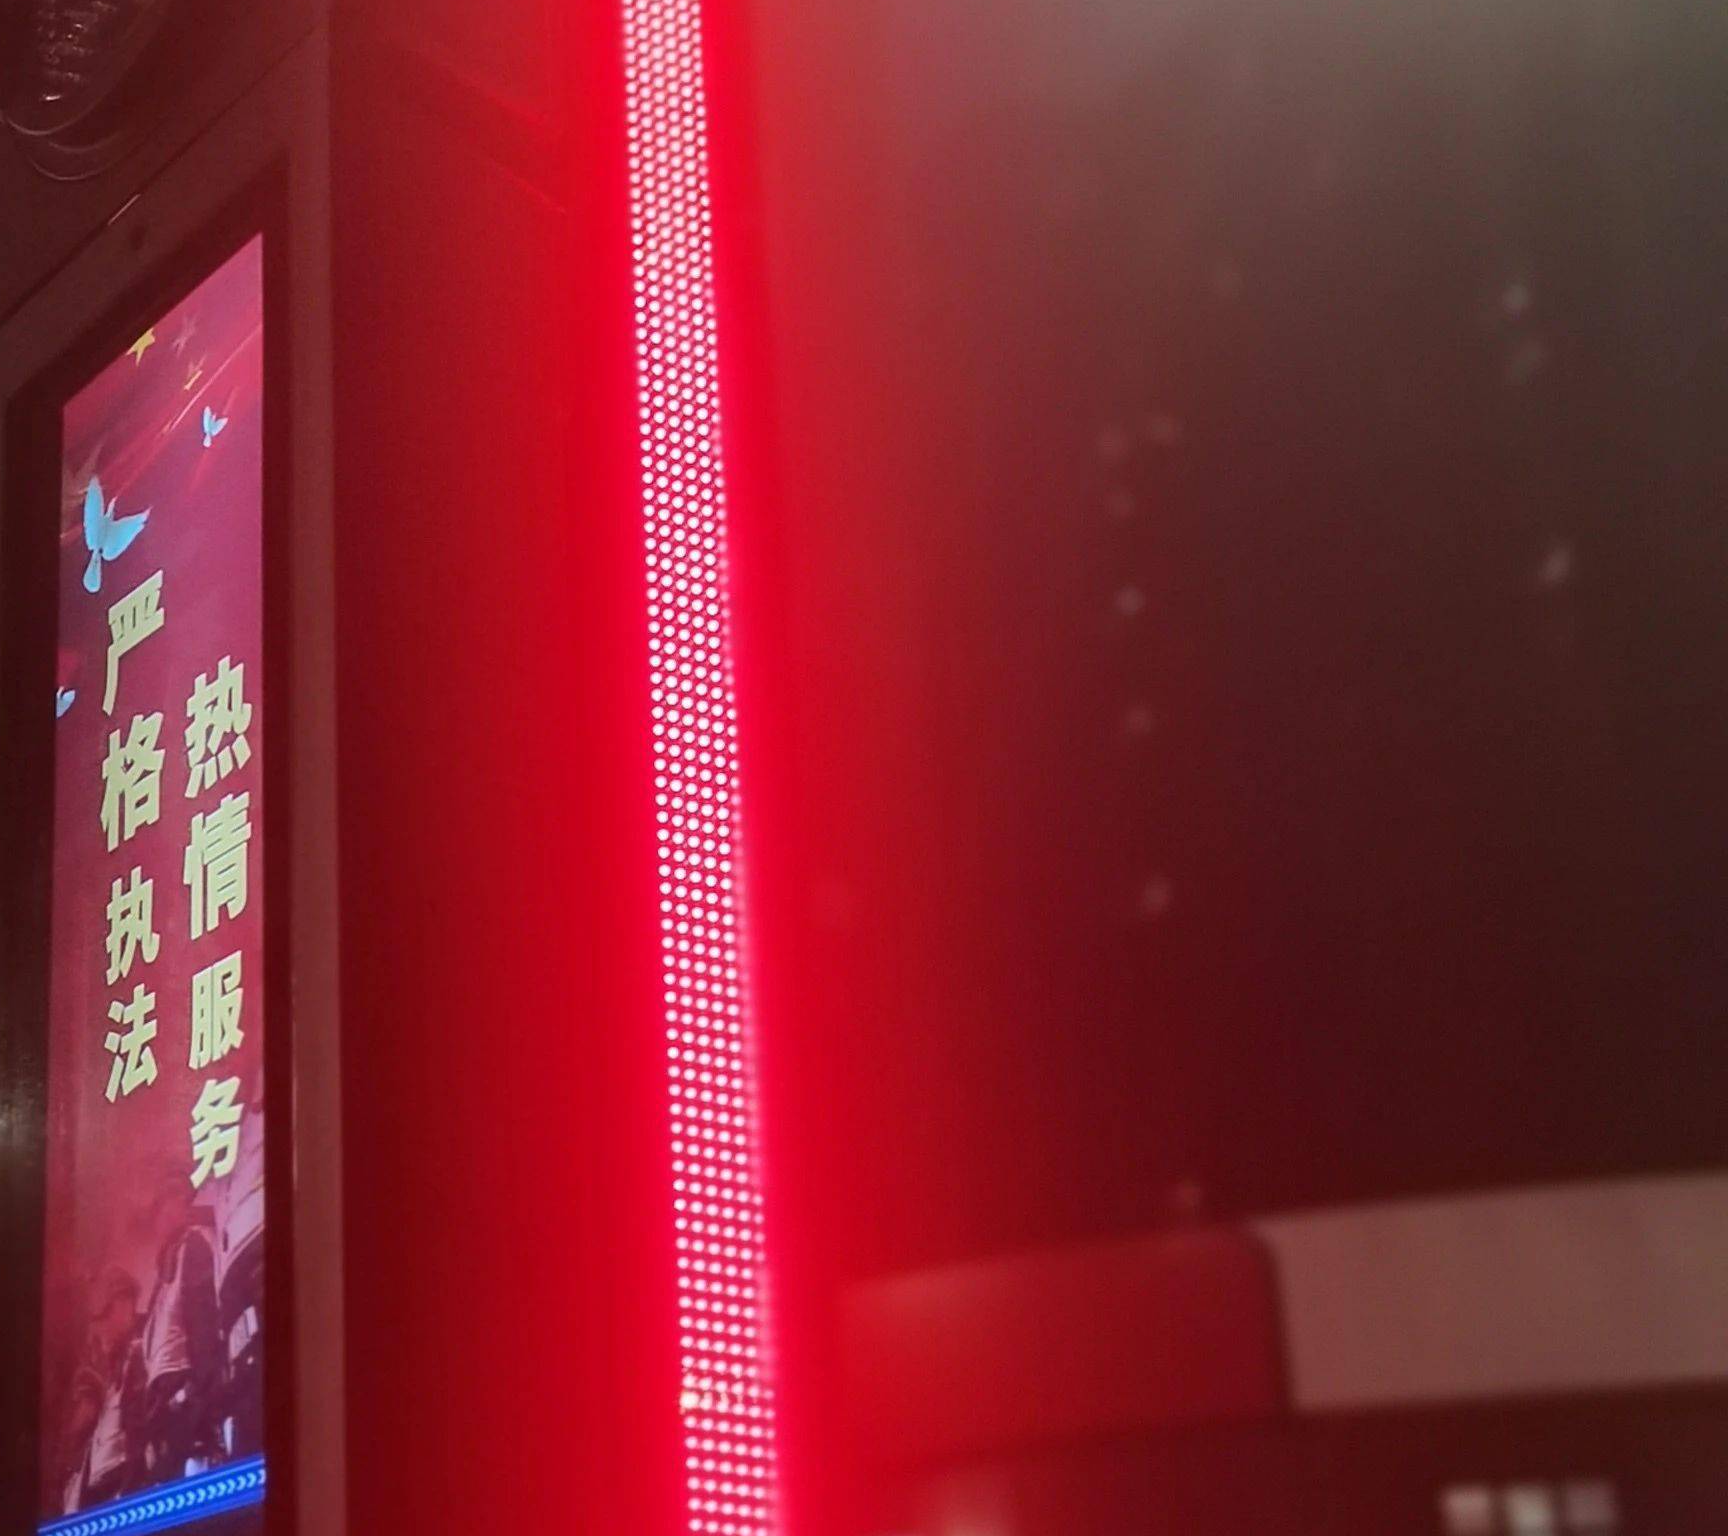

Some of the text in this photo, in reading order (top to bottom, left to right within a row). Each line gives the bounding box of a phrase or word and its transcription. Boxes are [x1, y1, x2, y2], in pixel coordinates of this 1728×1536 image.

[100, 569, 166, 1104] 严格执法
[182, 655, 253, 1190] 热情服务
